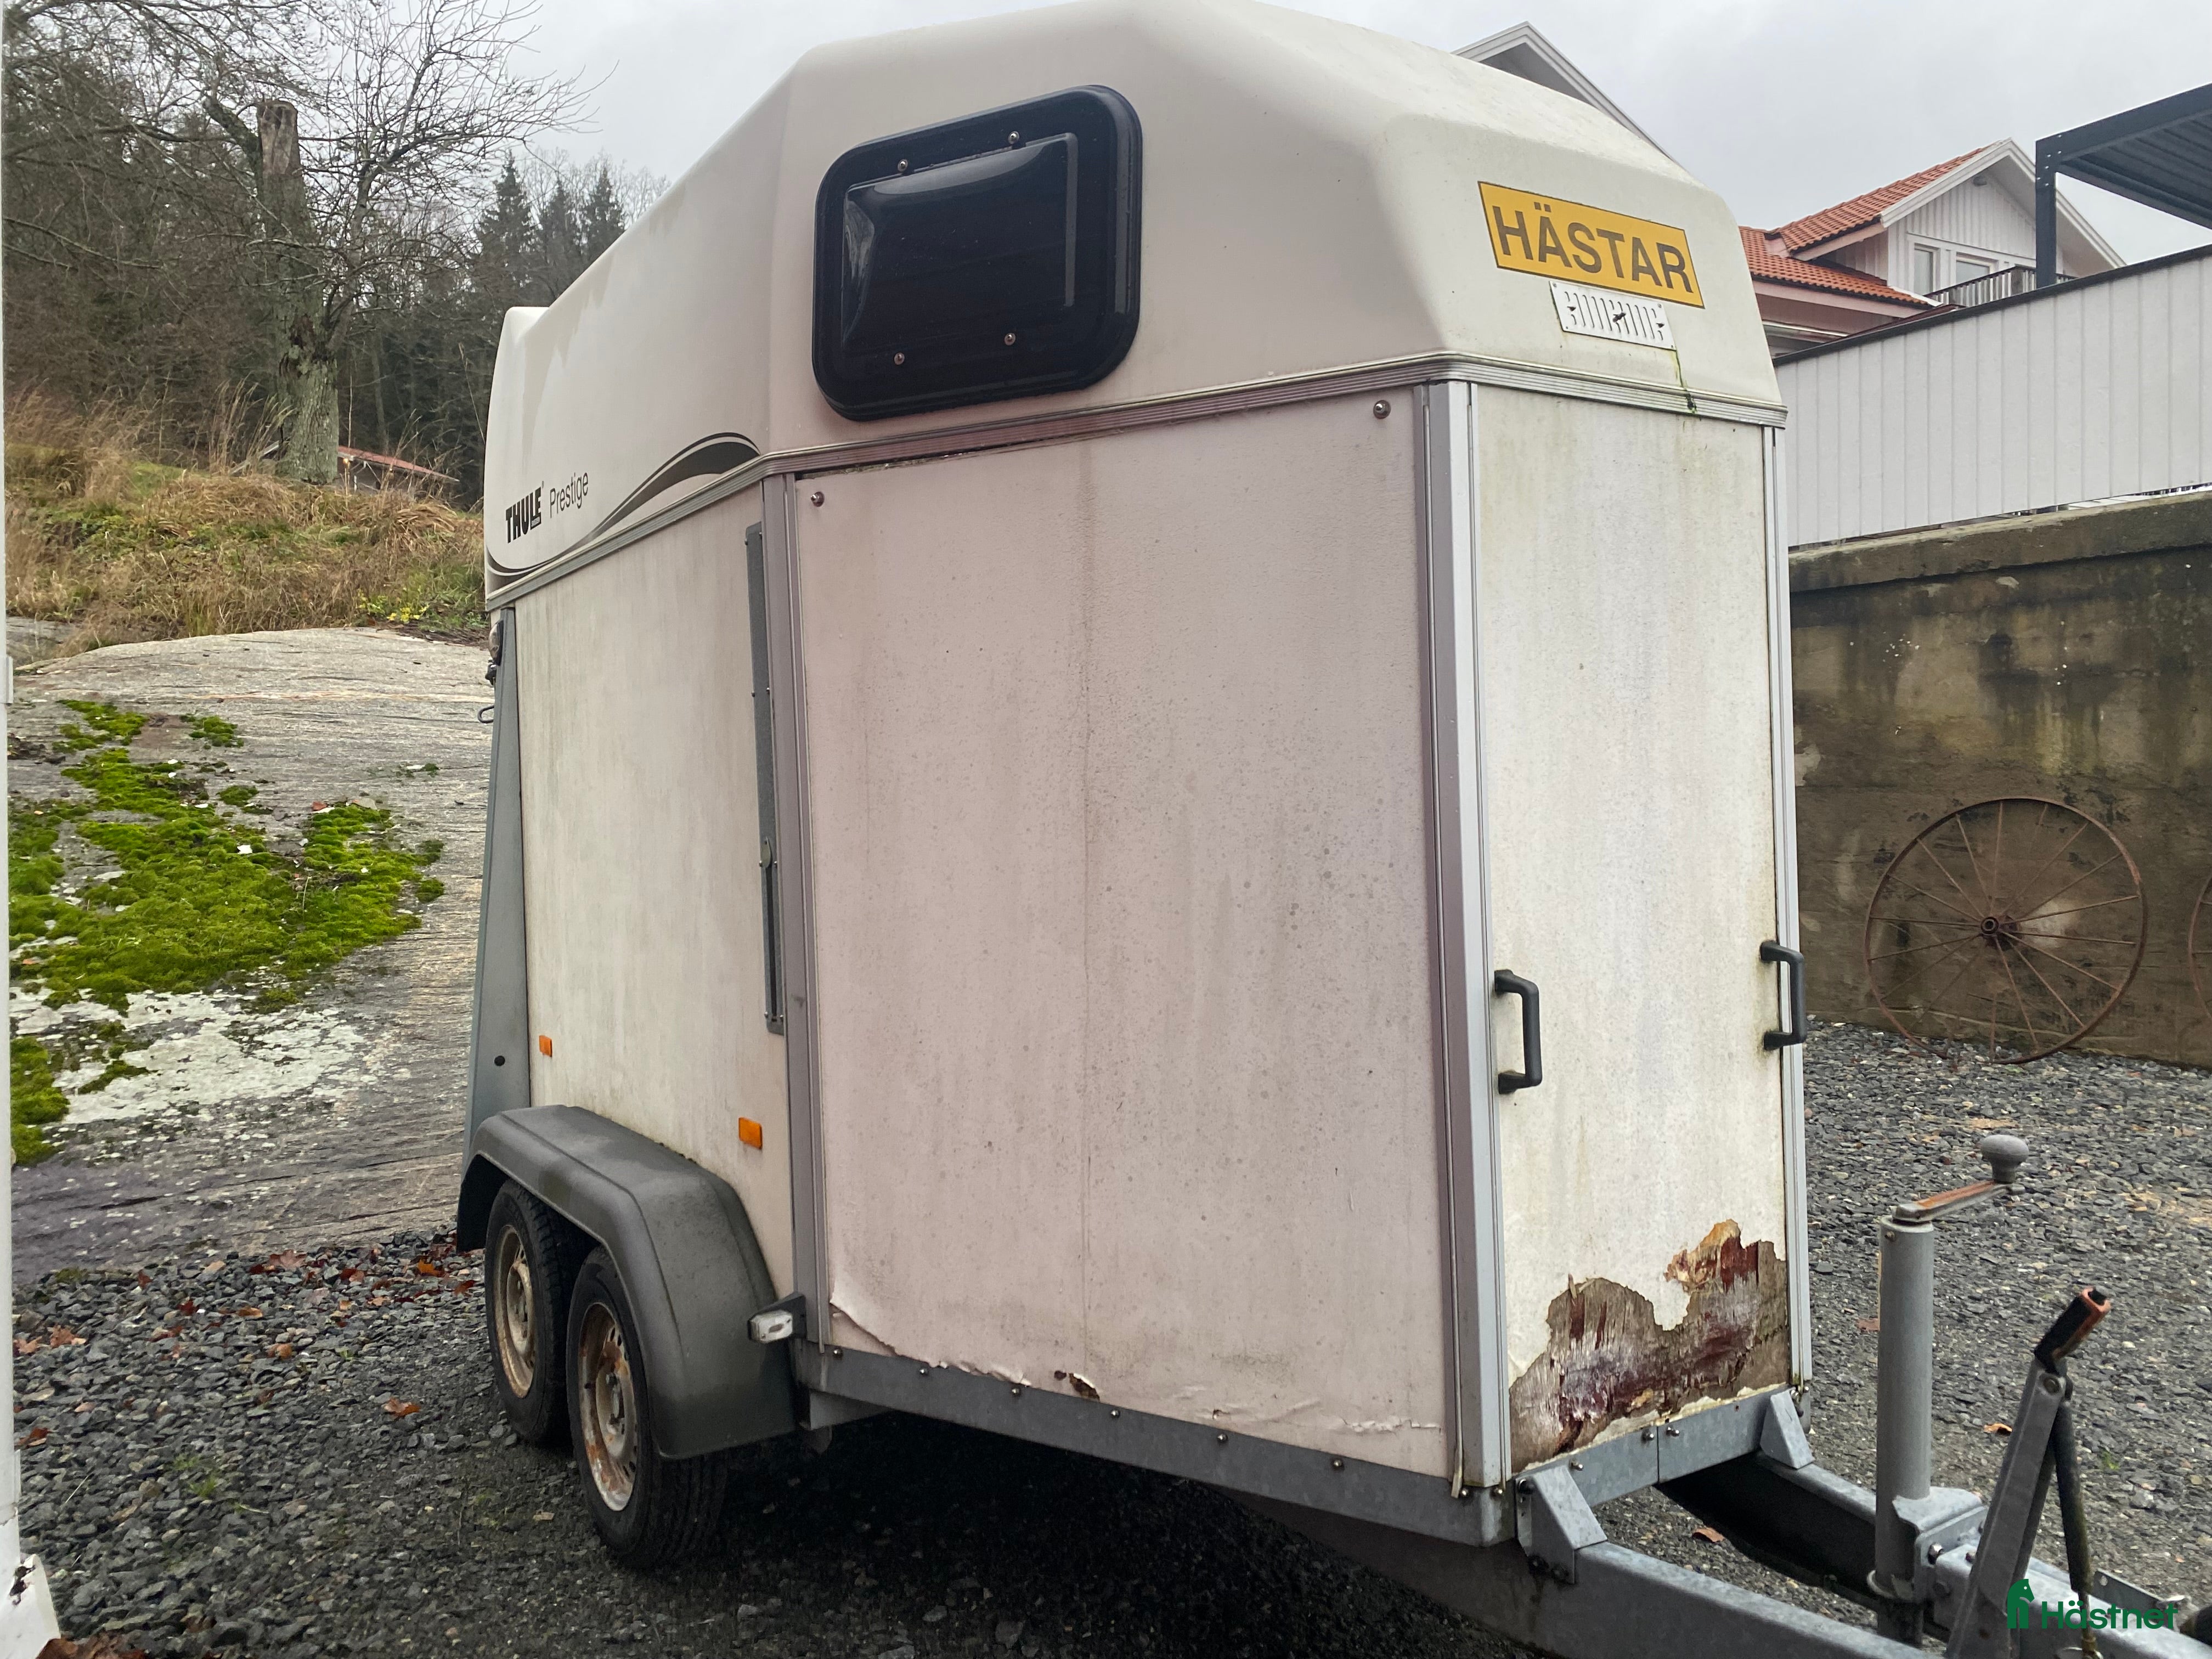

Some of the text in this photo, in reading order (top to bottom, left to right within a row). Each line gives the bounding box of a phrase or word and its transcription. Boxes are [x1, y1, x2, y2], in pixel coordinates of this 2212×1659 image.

[1492, 201, 1694, 294] HÄSTAR
[505, 472, 589, 544] THULE Prestige
